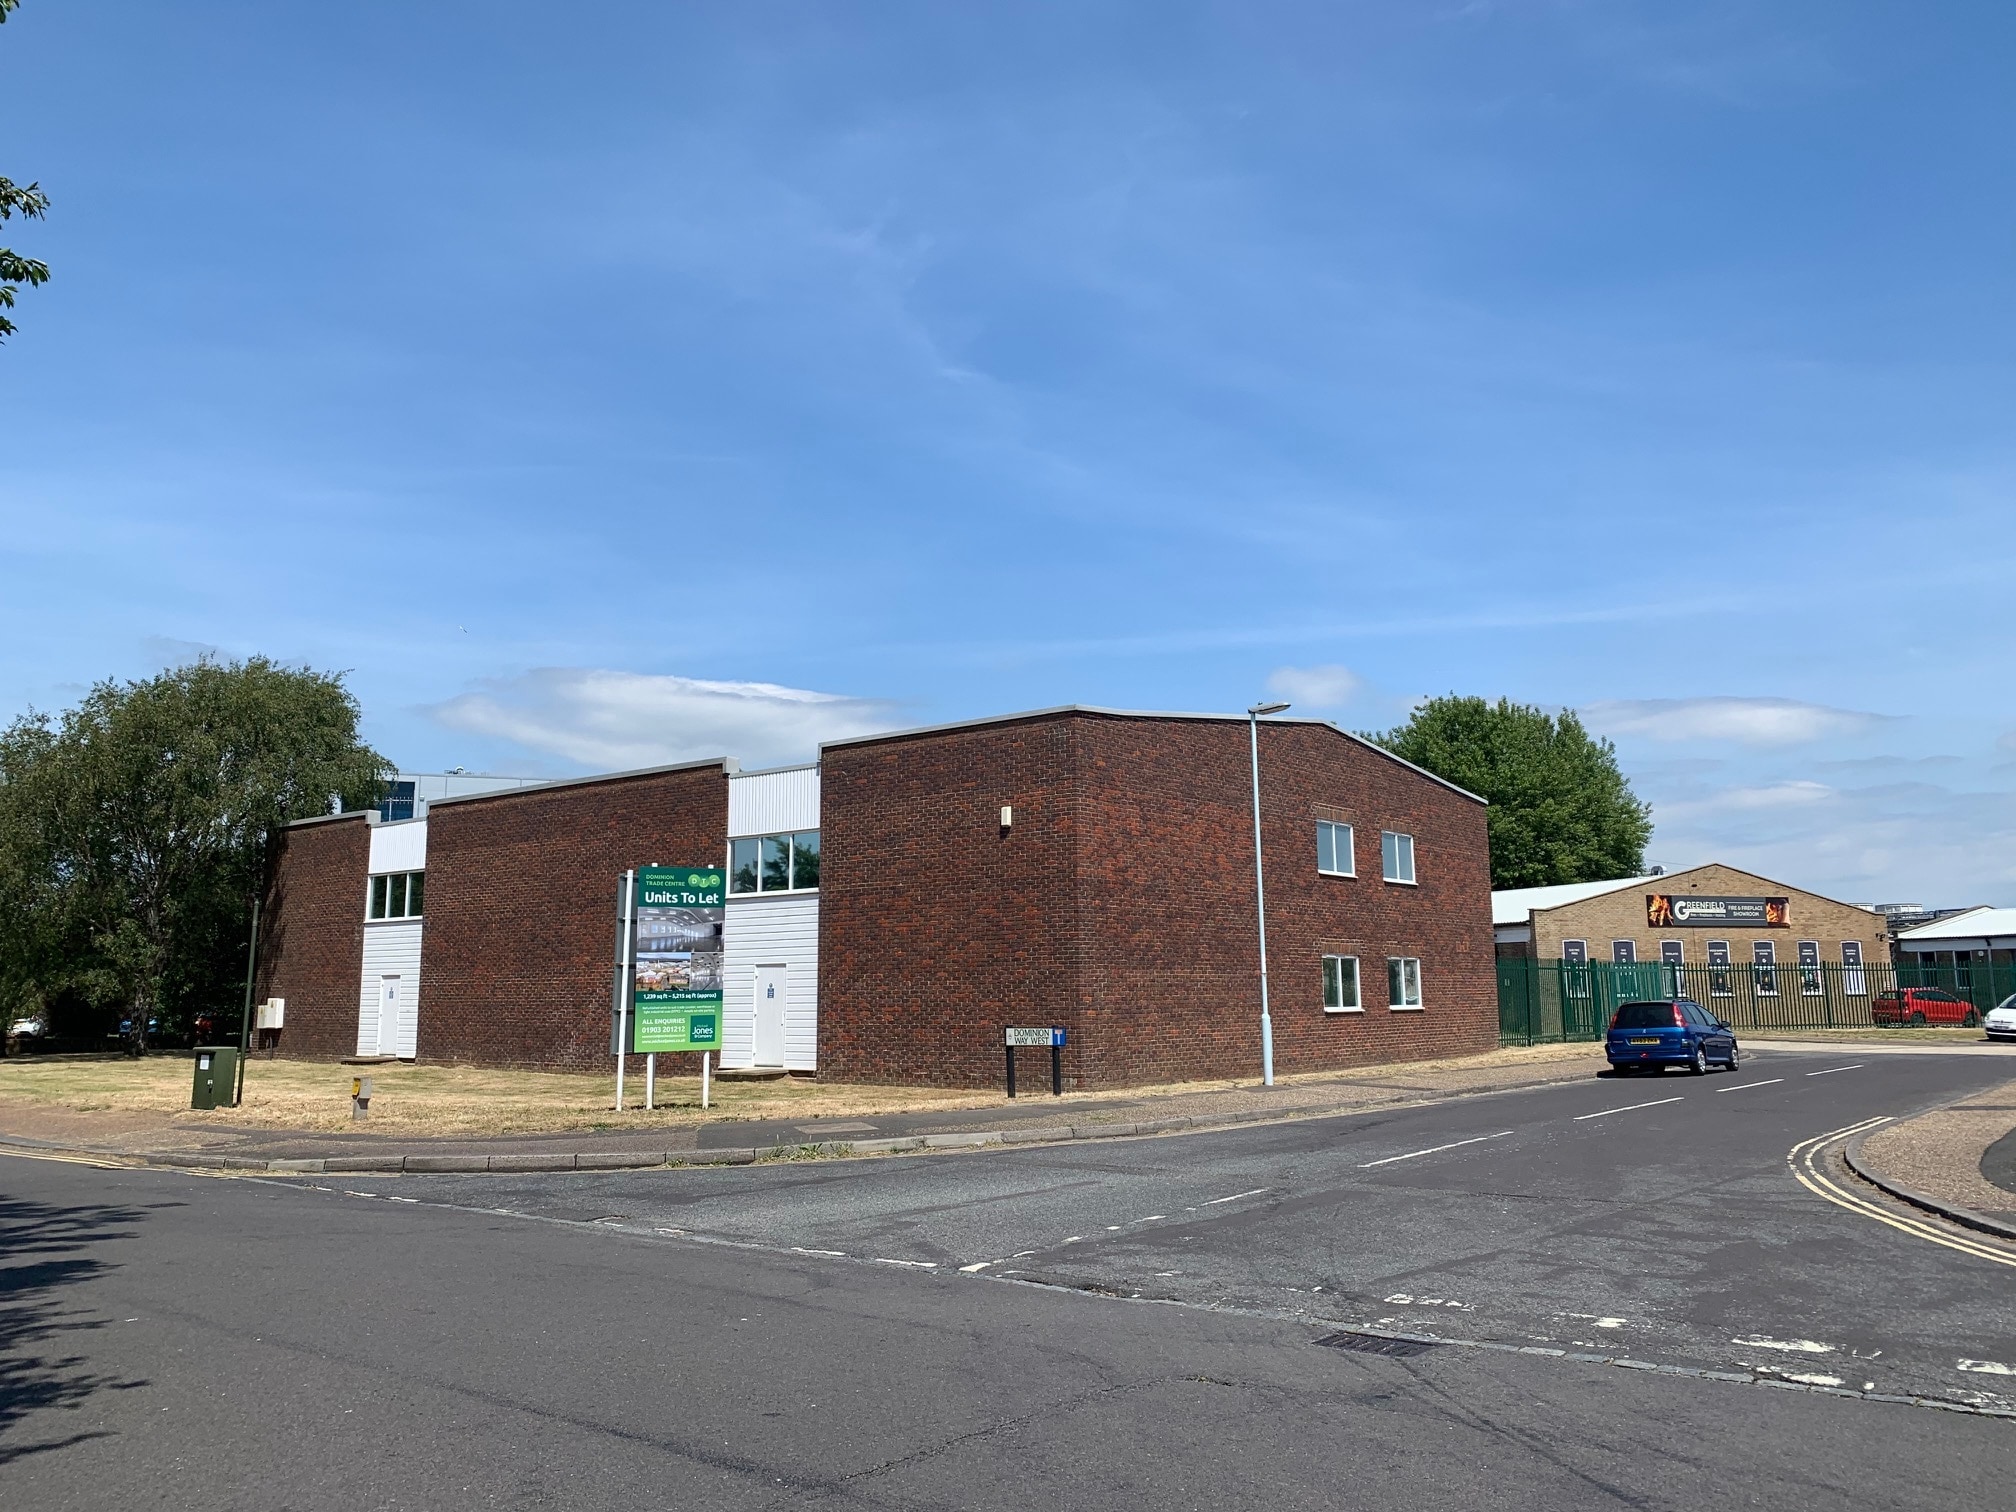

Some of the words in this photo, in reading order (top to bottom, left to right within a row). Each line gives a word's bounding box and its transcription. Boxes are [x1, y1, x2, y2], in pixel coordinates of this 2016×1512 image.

[645, 891, 678, 903] Units
[681, 892, 696, 904] To
[698, 892, 719, 904] Let
[1674, 900, 1727, 920] GREENFIELD
[1014, 1036, 1028, 1044] WAY
[1031, 1036, 1049, 1044] WEST
